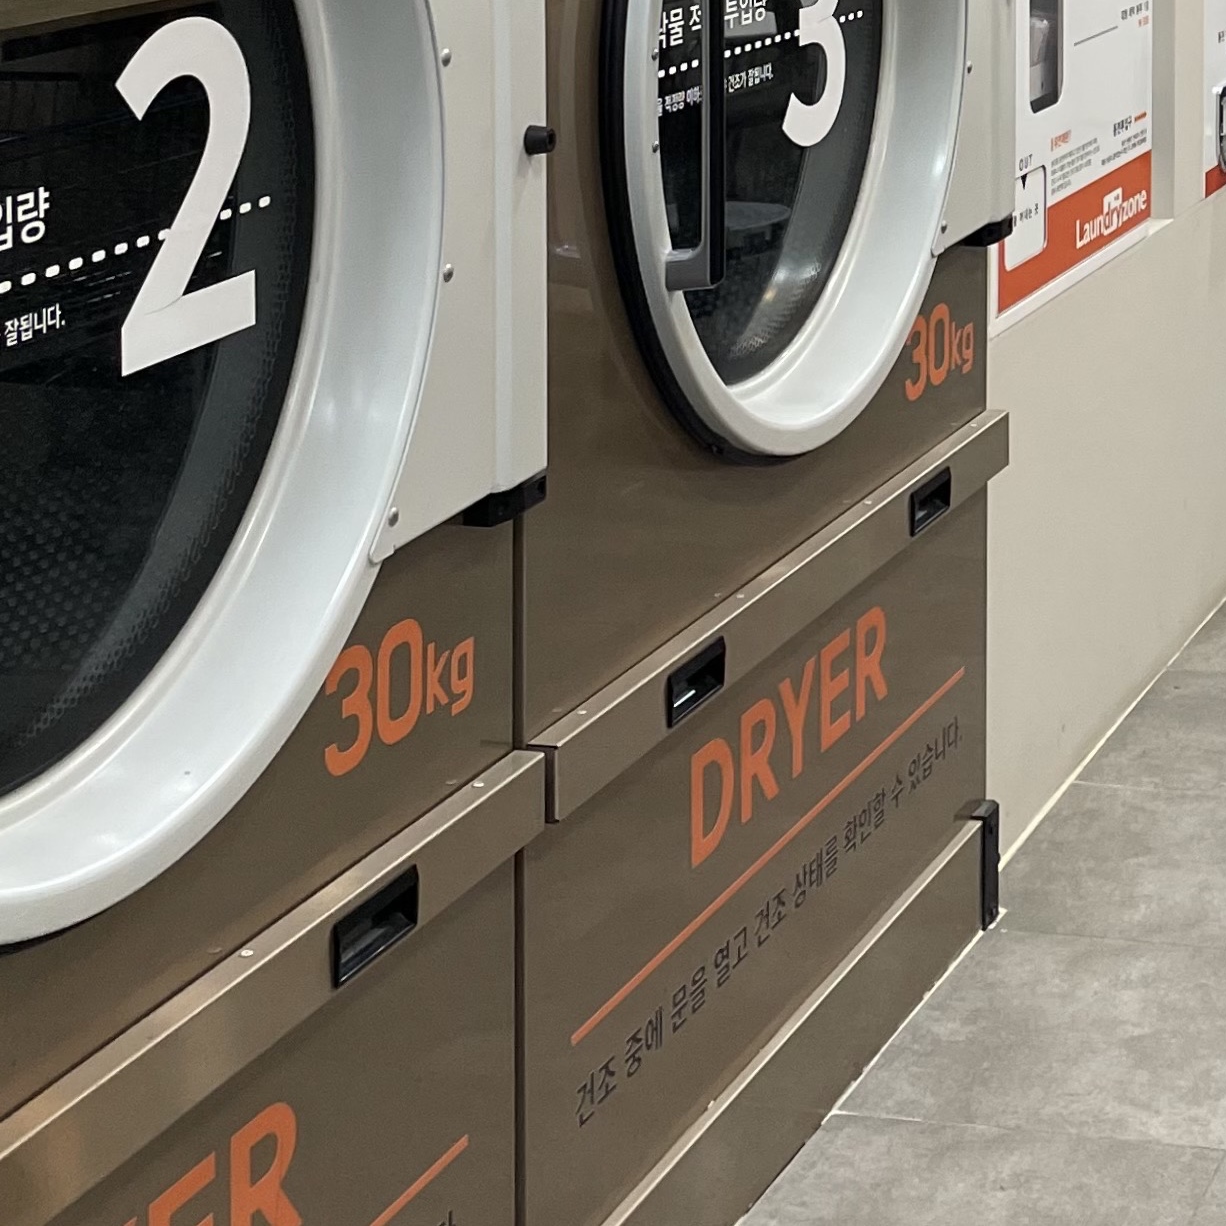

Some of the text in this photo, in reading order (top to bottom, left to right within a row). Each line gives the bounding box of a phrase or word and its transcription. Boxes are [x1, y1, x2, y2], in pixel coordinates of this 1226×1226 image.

[115, 16, 257, 377] 2
[1018, 153, 1033, 172] OUT
[1076, 187, 1148, 250] Laundryzone
[4, 302, 66, 347] 잘됩니다.
[905, 302, 974, 402] 30kg
[325, 618, 475, 778] 30kg
[691, 605, 888, 870] DRYER
[575, 716, 964, 1128] 건조 중에 문을 열고 건조 상태를 확인할 수 있습니다.
